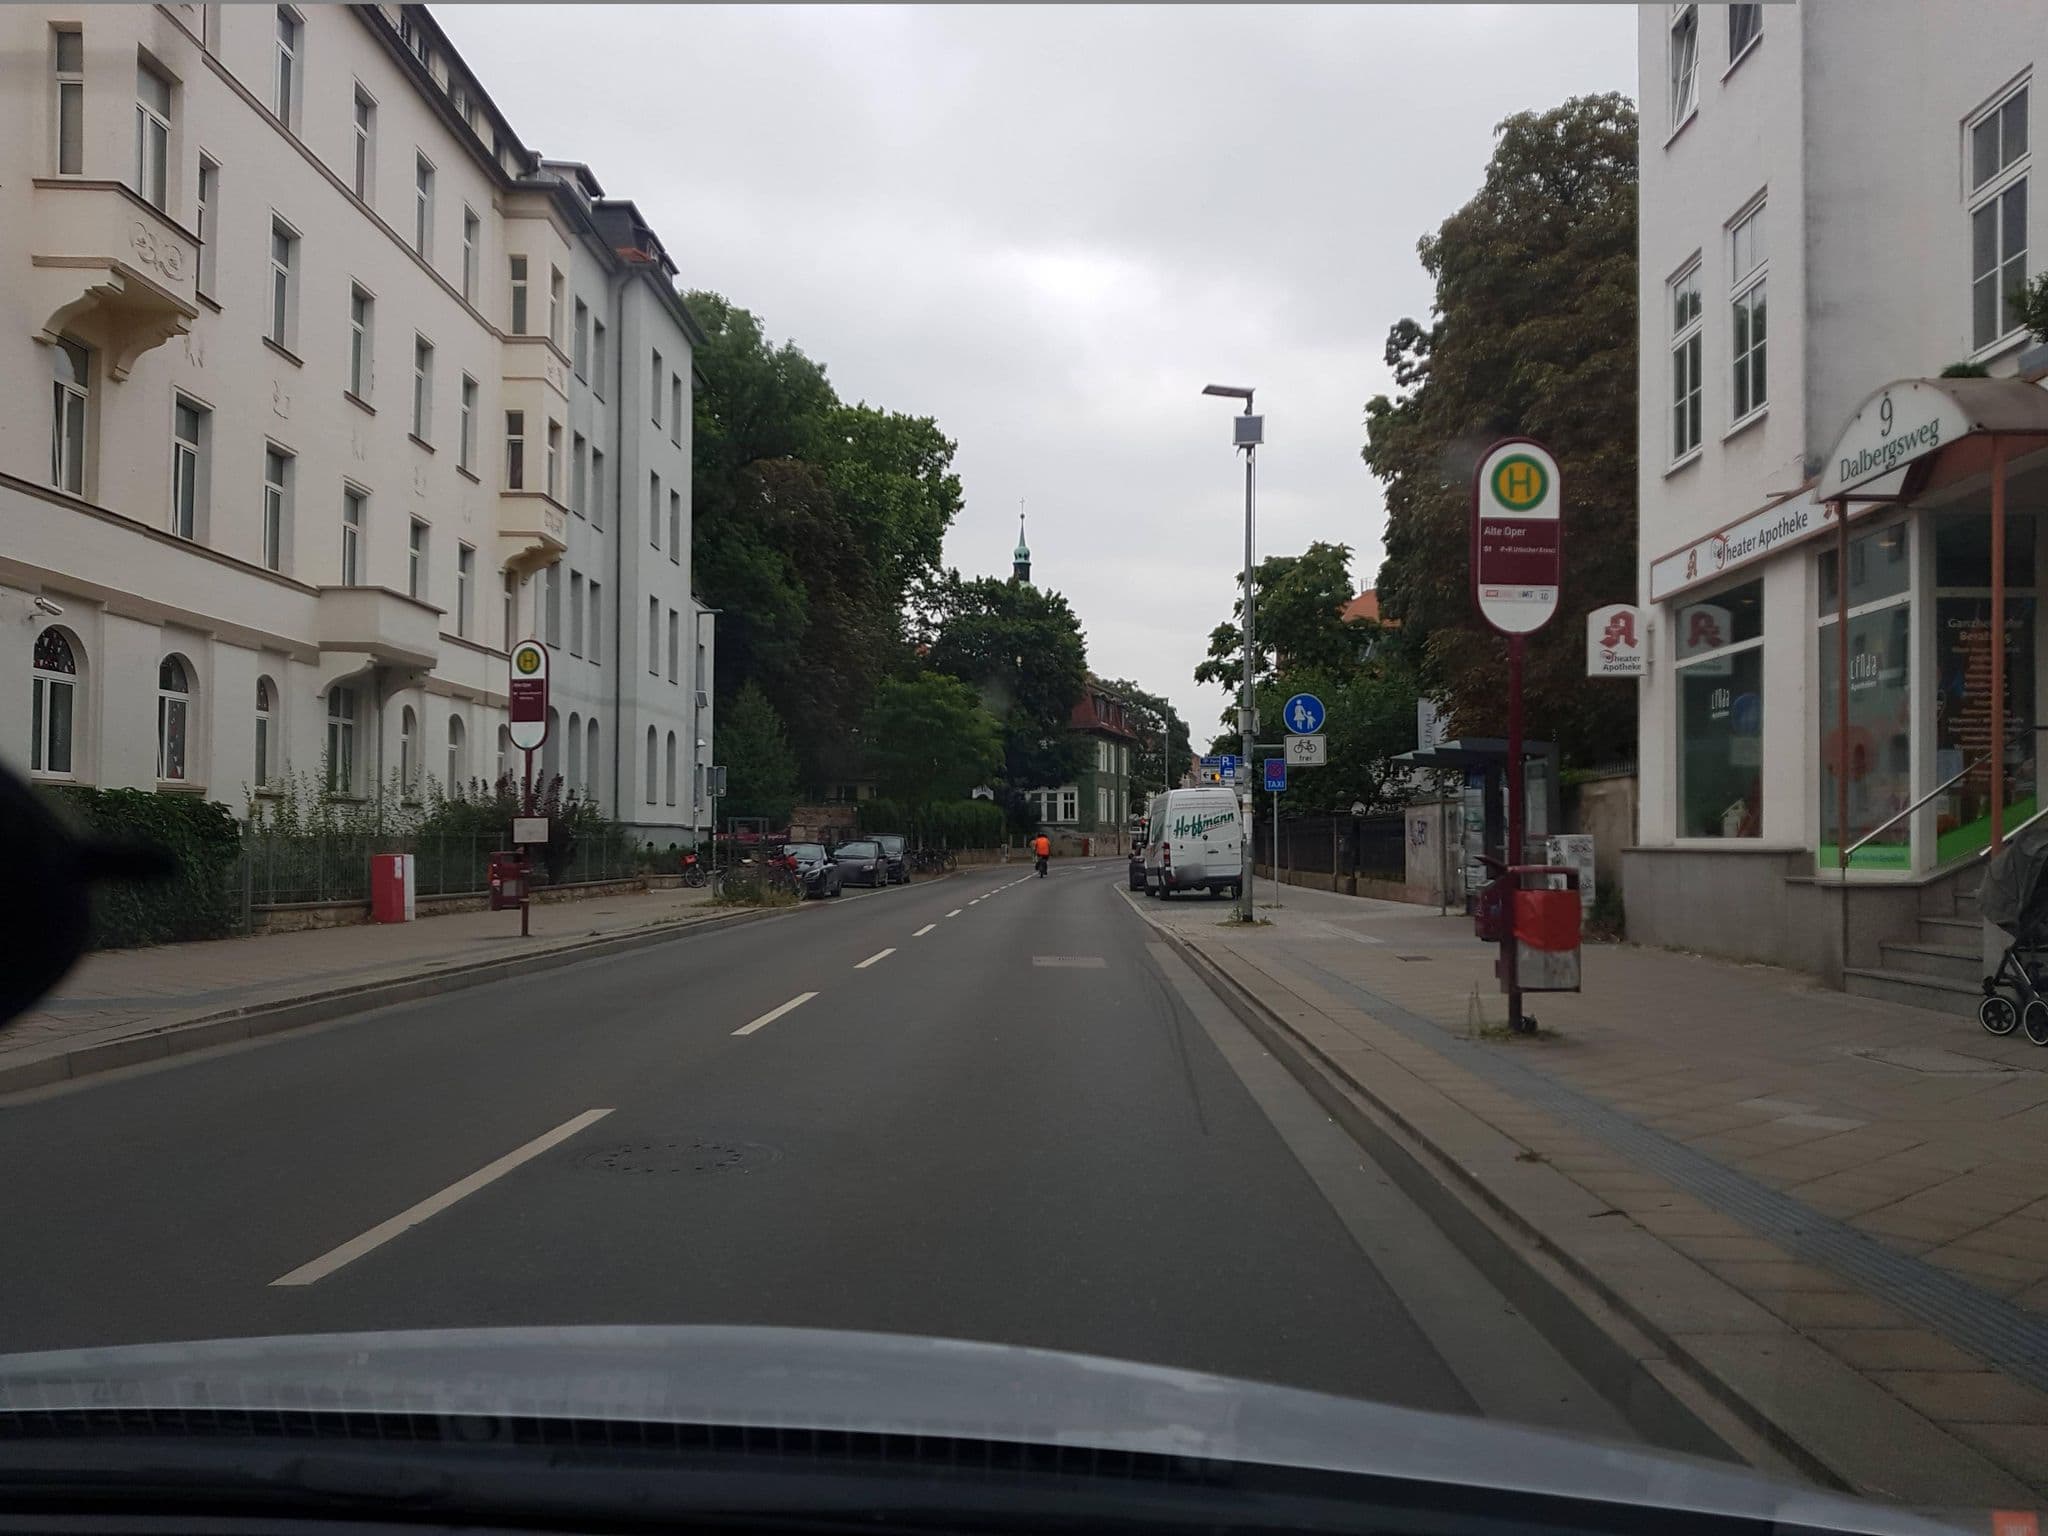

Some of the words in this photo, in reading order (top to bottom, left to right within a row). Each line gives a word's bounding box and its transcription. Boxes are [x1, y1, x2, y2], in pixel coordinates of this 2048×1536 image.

[1880, 397, 1893, 437] 9
[1840, 417, 1940, 484] Dalbergsweg
[1508, 466, 1532, 499] H
[1484, 526, 1503, 537] Alte
[1504, 526, 1528, 539] Oper
[1758, 511, 1809, 550] Apotheke
[1267, 780, 1286, 789] TAXI
[1173, 811, 1235, 838] Hoffmann
